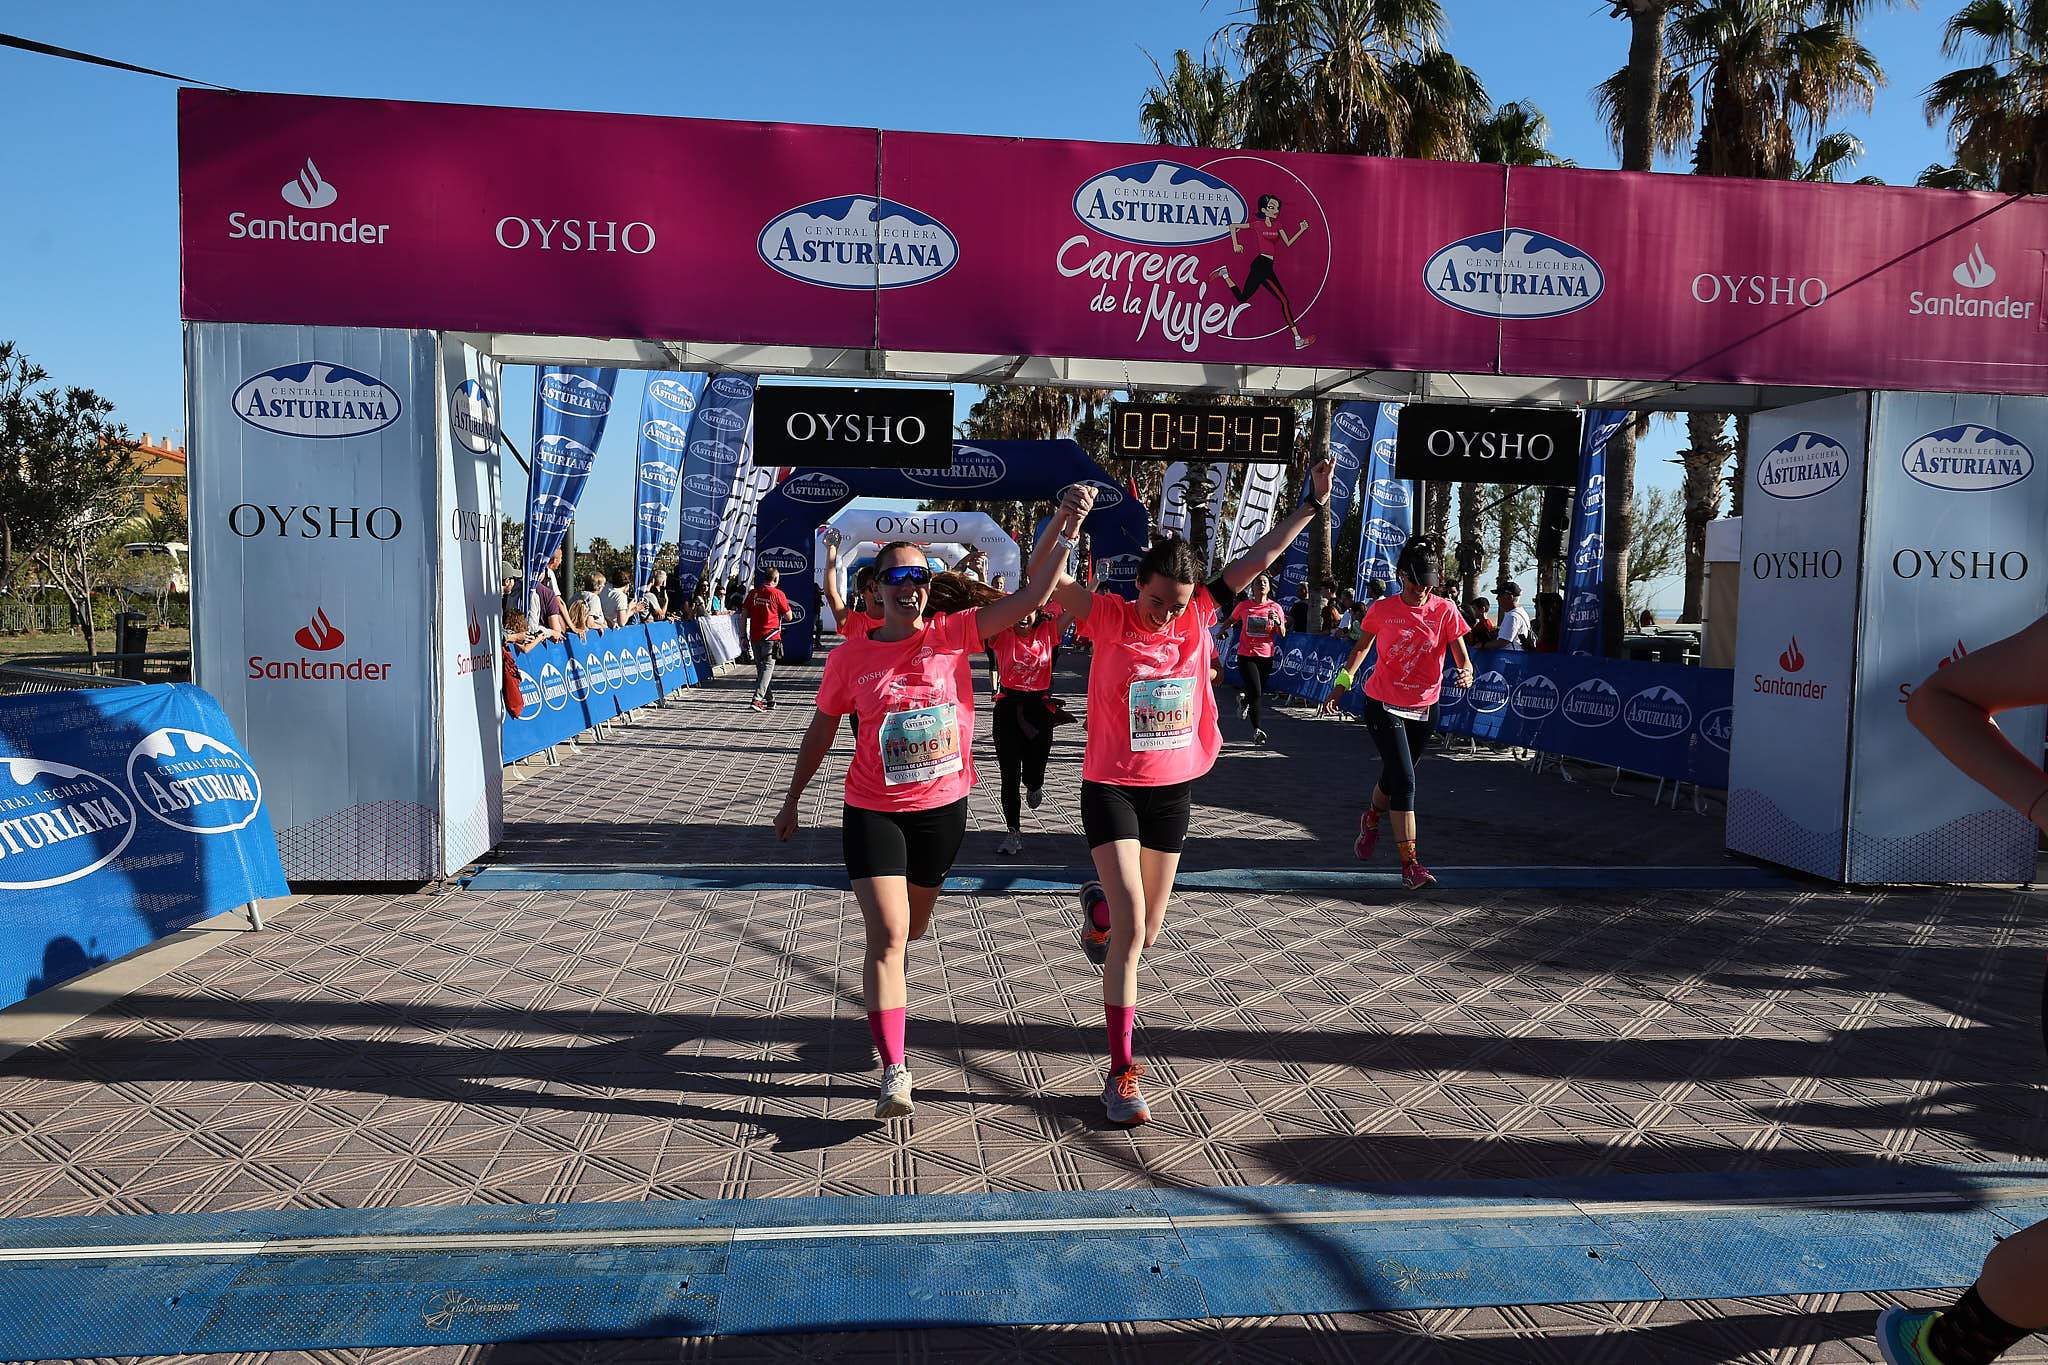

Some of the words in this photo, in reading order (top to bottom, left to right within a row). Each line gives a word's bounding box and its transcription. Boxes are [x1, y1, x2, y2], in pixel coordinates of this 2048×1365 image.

[1086, 188, 1234, 227] ASTURIANA
[1114, 187, 1169, 199] CENTRAL
[1174, 190, 1230, 202] LECHERA
[228, 211, 390, 245] Santander
[495, 216, 657, 255] OYSHO
[805, 225, 868, 237] CENTRAL
[874, 227, 938, 239] LECHERA
[773, 226, 944, 267] ASTURIANA
[1056, 235, 1200, 285] Carrera
[1437, 258, 1590, 297] ASTURIANA
[1466, 257, 1522, 269] CENTRAL
[1528, 260, 1586, 271] LECHERA
[1690, 273, 1830, 307] OYSHO
[1090, 283, 1117, 314] de
[1122, 284, 1142, 315] la
[1136, 281, 1252, 353] Mujer
[1908, 291, 2035, 319] Santander
[245, 388, 389, 420] ASTURIANA
[271, 387, 325, 397] CENTRAL
[330, 389, 384, 398] LECHERA
[541, 381, 607, 412] ASTURIANA
[454, 400, 496, 442] ASTURIANA
[702, 411, 741, 428] ASTURIANA
[786, 412, 926, 445] OYSHO
[1427, 429, 1555, 461] OYSHO
[1932, 446, 1974, 455] CENTRAL
[1977, 447, 2021, 456] LECHERA
[1762, 459, 1841, 486] ASTURIANA
[1911, 447, 2023, 475] ASTURIANA
[786, 483, 844, 497] ASTURIANA
[227, 503, 402, 541] OYSHO
[451, 508, 496, 545] OYSHO
[875, 516, 959, 535] OYSHO
[759, 556, 804, 569] ASTURIANA
[1753, 549, 1842, 580] OYSHO
[1892, 548, 2029, 581] OYSHO
[248, 656, 392, 681] Santander
[456, 652, 494, 676] Santander
[1513, 689, 1554, 710] ASTURIANA
[1753, 673, 1827, 700] Santander
[1565, 694, 1616, 718] ASTURIANA
[1627, 701, 1683, 729] ASTURIANA
[158, 760, 203, 776] CENTRAL
[34, 780, 99, 803] LECHERA
[0, 797, 129, 860] TURIANA
